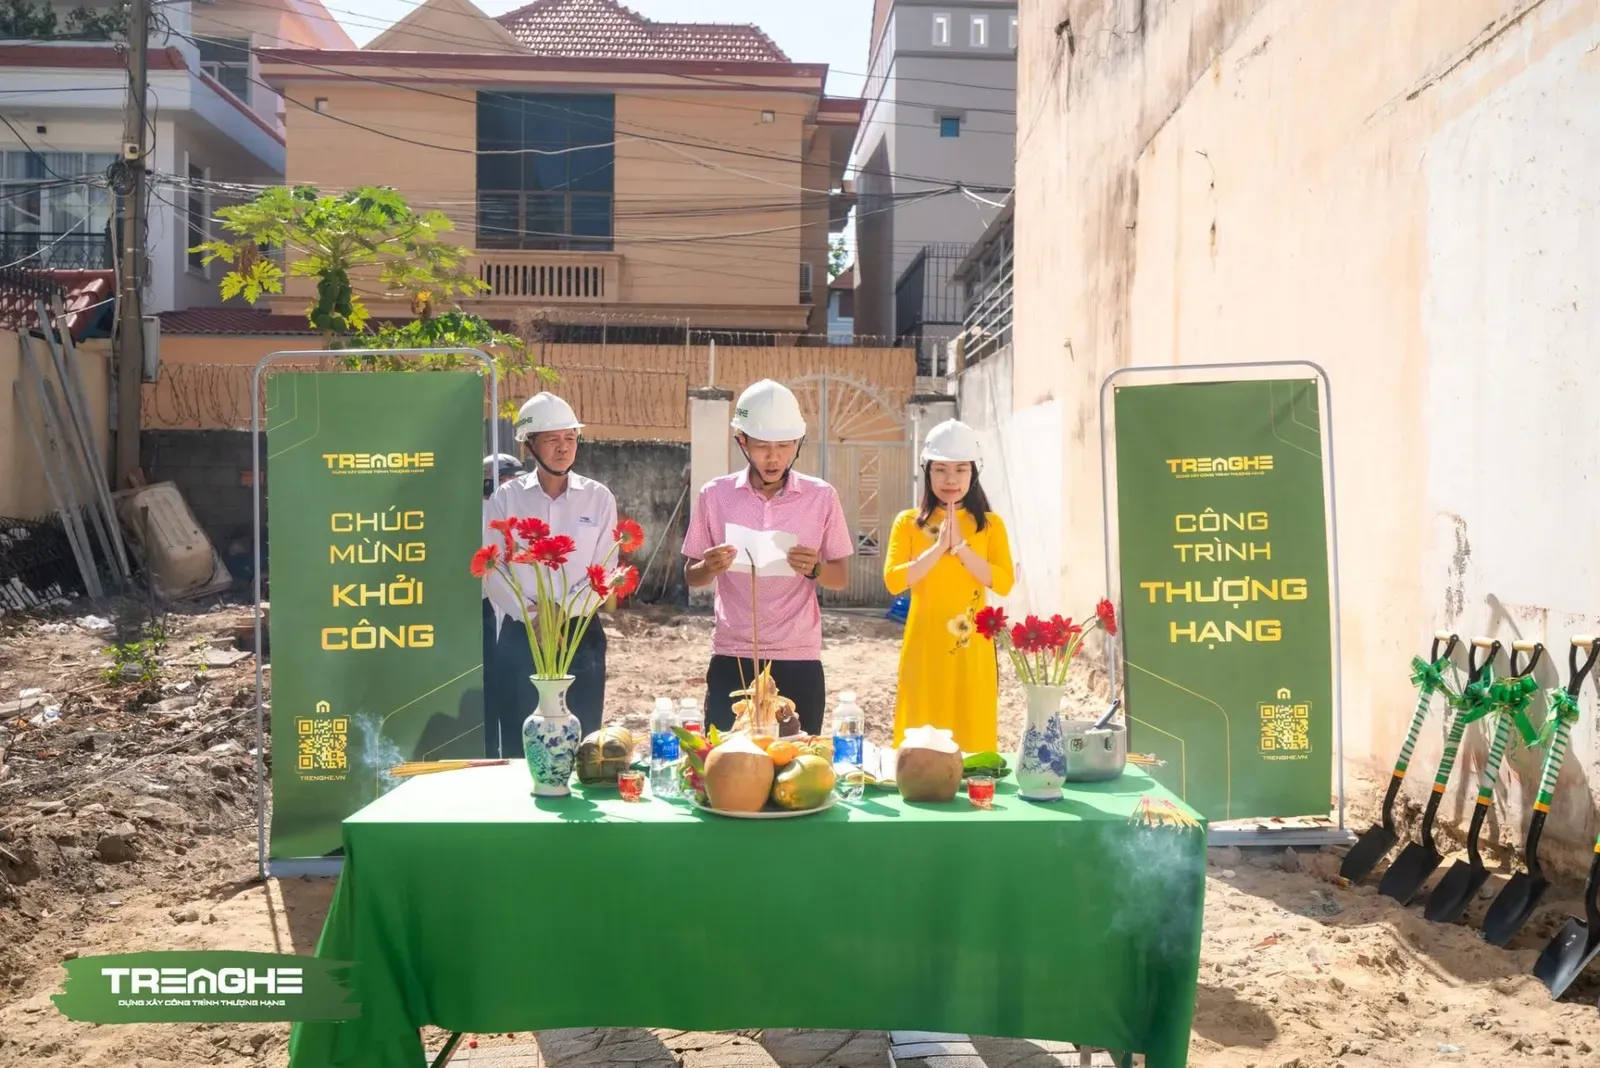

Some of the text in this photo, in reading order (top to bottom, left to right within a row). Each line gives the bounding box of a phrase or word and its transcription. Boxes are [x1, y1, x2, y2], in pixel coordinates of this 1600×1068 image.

[322, 452, 434, 469] TRENGHE
[1166, 455, 1274, 473] TRENGHE
[331, 505, 425, 532] CHÚC
[1175, 507, 1269, 533] CÔNG
[330, 537, 426, 564] MỪNG
[1173, 537, 1271, 562] TRÌNH
[332, 574, 423, 607] KHỞI
[1140, 576, 1308, 609] THƯỢNG
[321, 618, 434, 650] CÔNG
[1170, 620, 1282, 650] HẠNG
